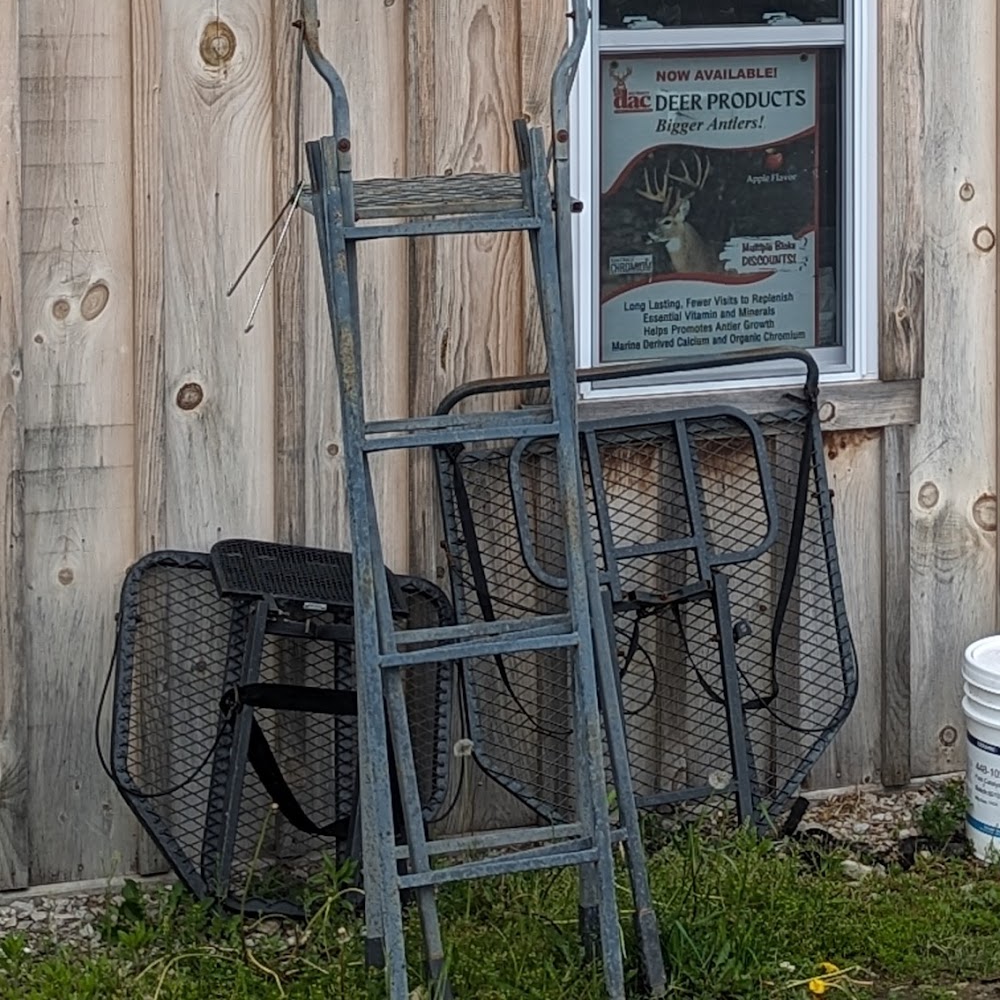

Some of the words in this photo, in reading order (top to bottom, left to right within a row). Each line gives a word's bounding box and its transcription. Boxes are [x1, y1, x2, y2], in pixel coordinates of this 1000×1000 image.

[656, 70, 691, 83] NOW
[694, 67, 778, 82] AVAILABLE!
[613, 88, 652, 110] dac
[655, 94, 703, 112] DEER
[707, 90, 806, 110] PRODUCTS
[656, 118, 704, 136] Bigger
[706, 115, 765, 132] Antlers!
[746, 173, 770, 185] Apple
[771, 172, 798, 182] Flavor
[742, 253, 797, 267] DISCOUNTS!
[624, 301, 646, 313] Long
[649, 299, 683, 312] Lasting,
[686, 297, 712, 308] Fewer
[714, 294, 738, 306] Visits
[740, 295, 749, 305] to
[752, 292, 794, 305] Replenish
[643, 310, 682, 323] Essential
[685, 308, 718, 321] Vitamin
[720, 307, 736, 318] and
[738, 306, 776, 318] Minerals
[643, 324, 668, 337] Helps
[671, 321, 713, 334] Promotes
[743, 318, 775, 330] Growth
[611, 339, 641, 352] Marine
[643, 337, 674, 350] Derived
[676, 335, 710, 347] Calcium
[712, 333, 727, 345] and
[729, 331, 762, 345] Organic
[763, 329, 806, 343] Chromium
